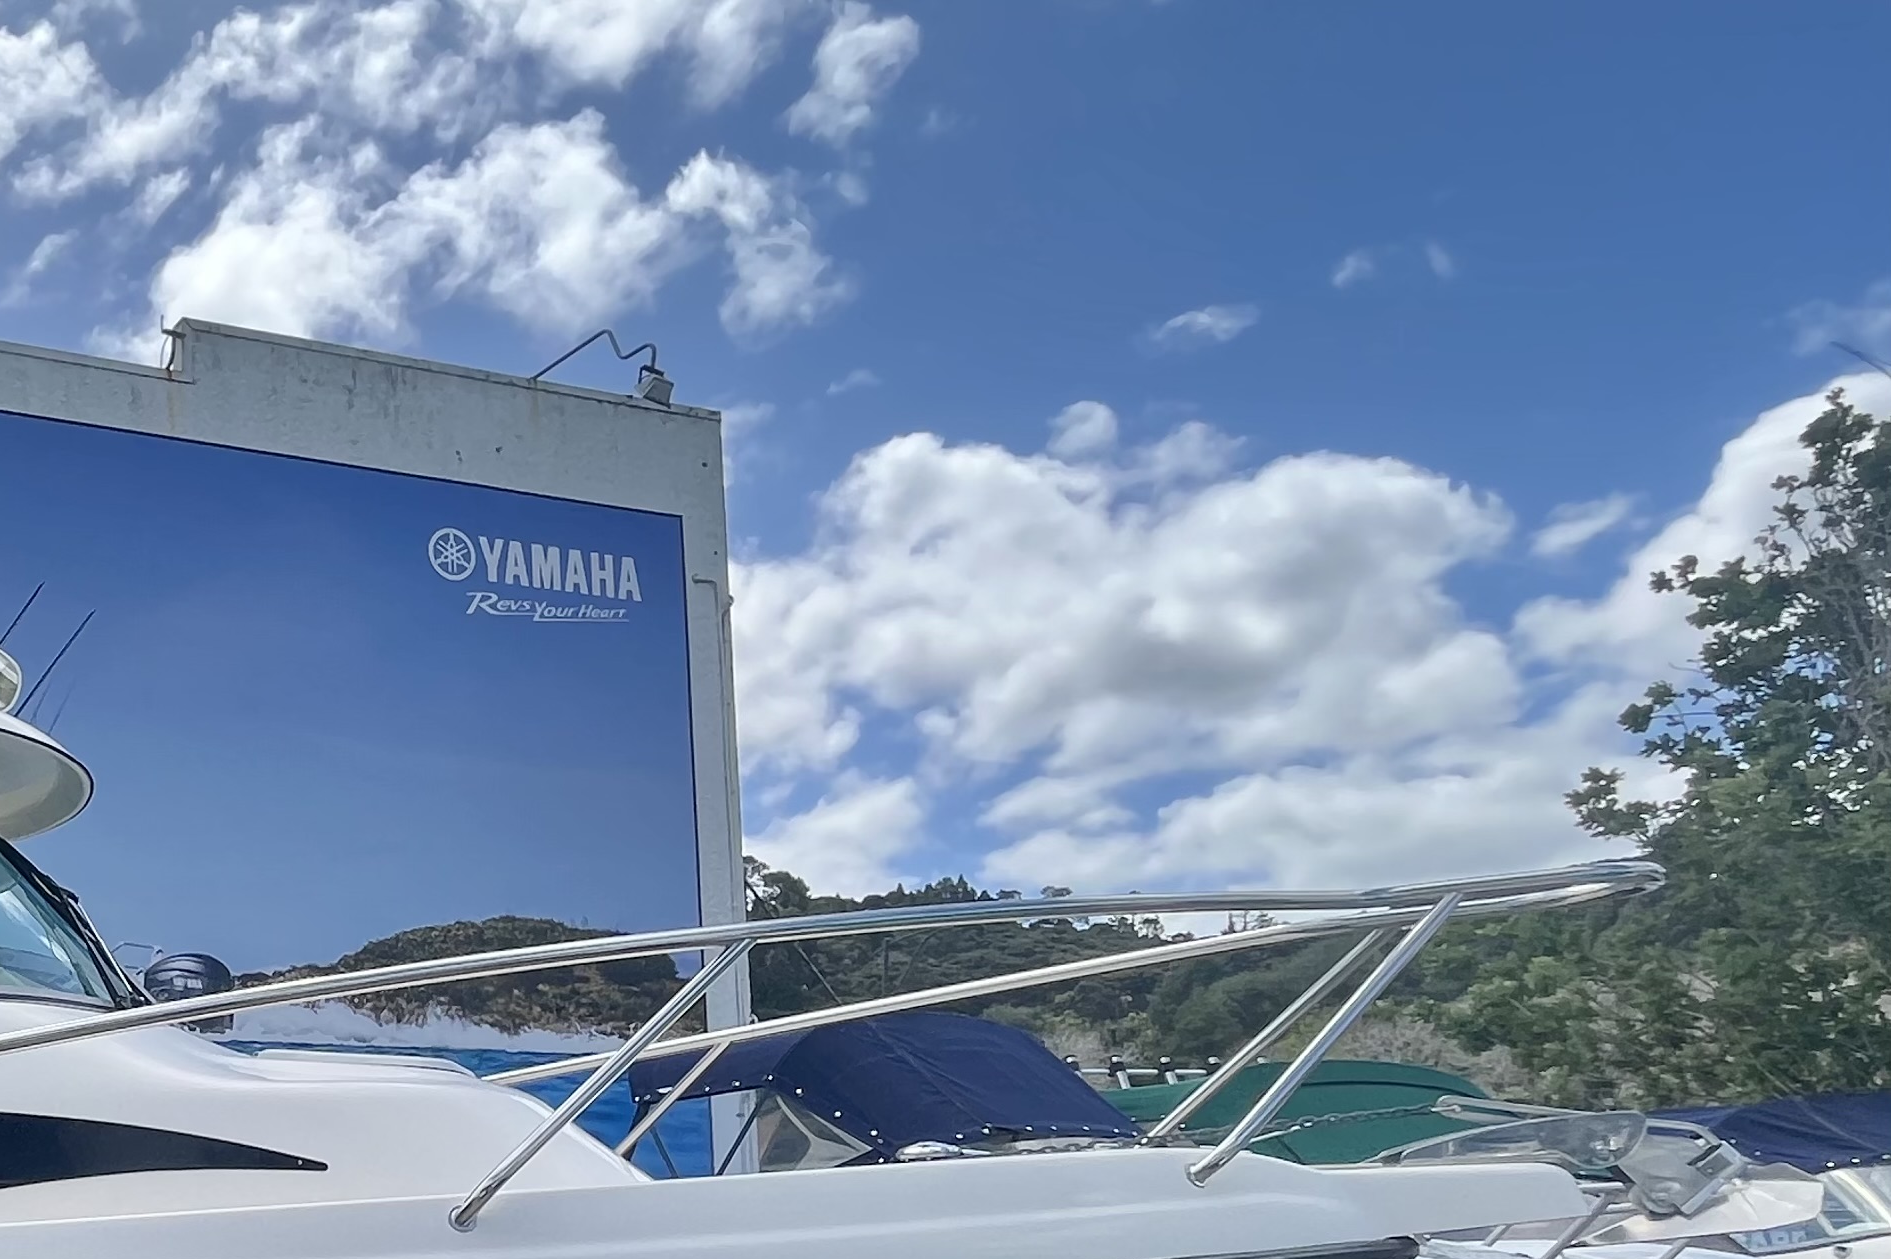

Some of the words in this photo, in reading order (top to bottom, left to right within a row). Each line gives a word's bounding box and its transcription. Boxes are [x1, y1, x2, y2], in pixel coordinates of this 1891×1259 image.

[478, 536, 642, 602] YAMAHA
[465, 591, 532, 615] Revs
[578, 604, 627, 619] Heart
